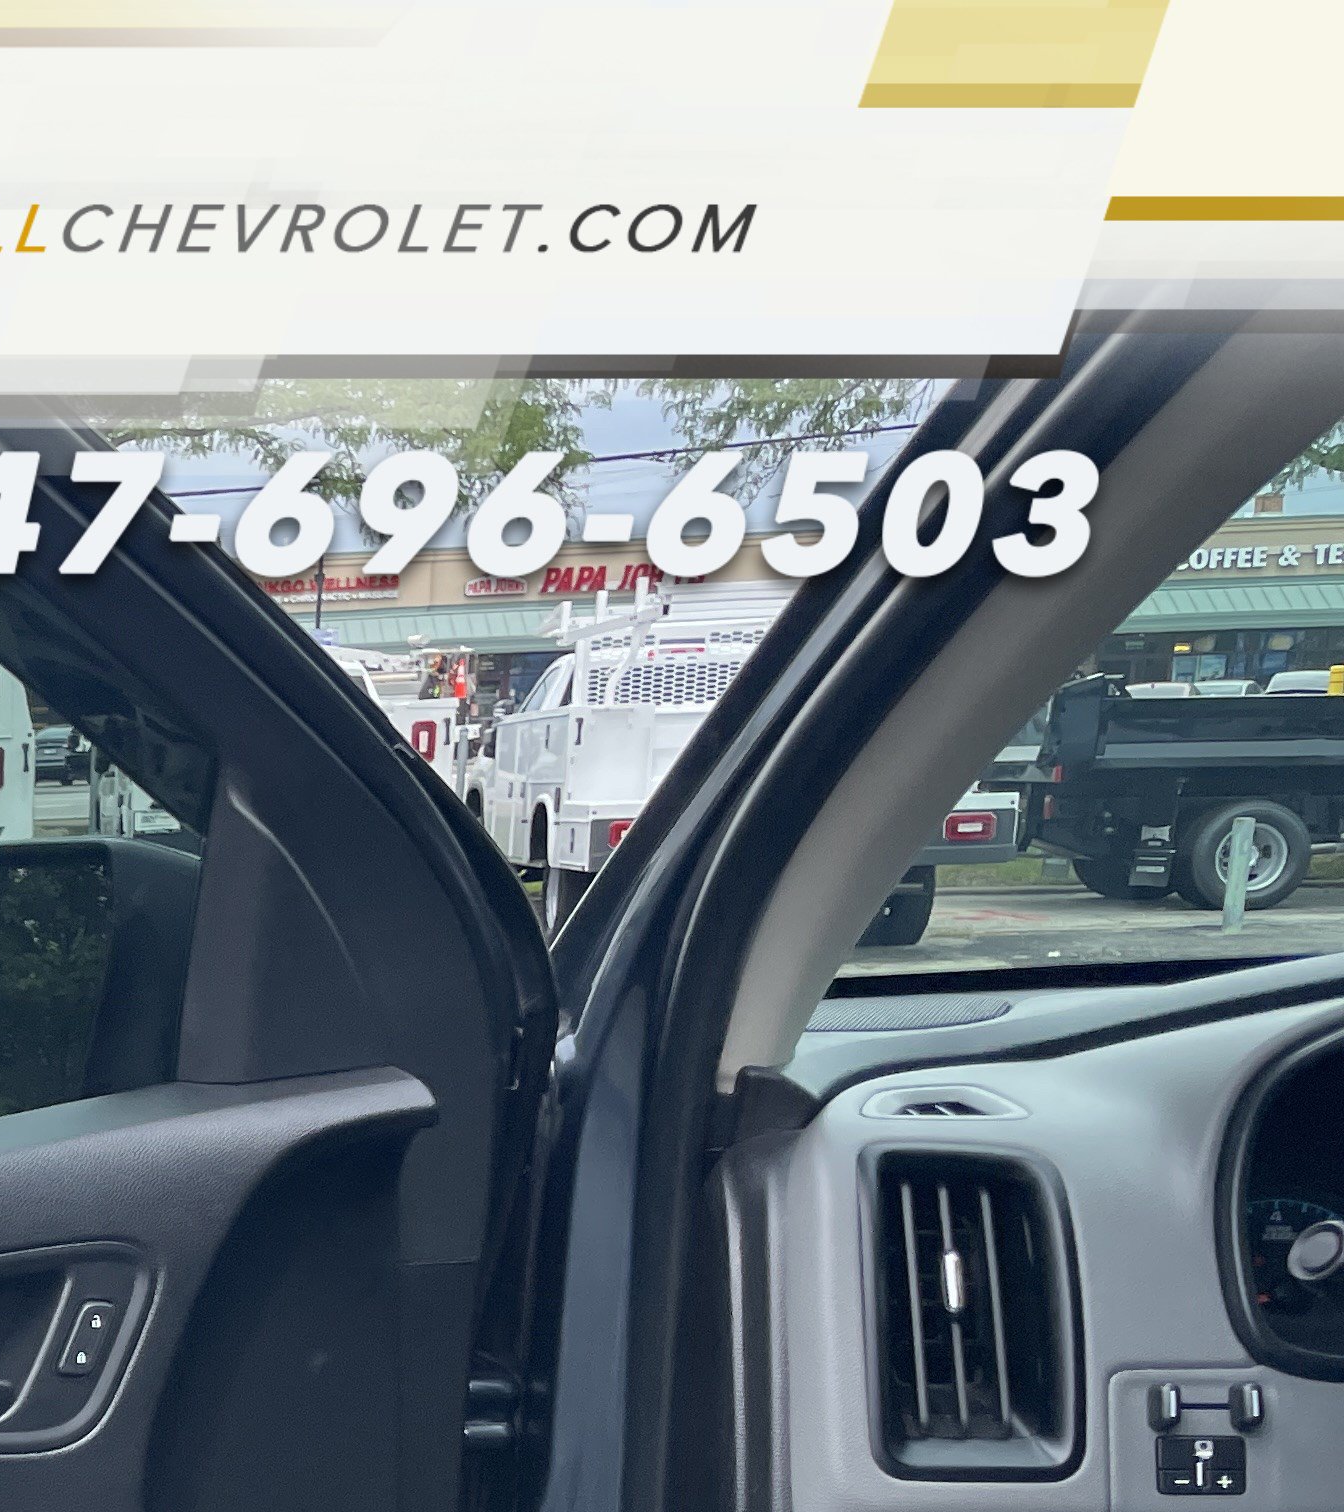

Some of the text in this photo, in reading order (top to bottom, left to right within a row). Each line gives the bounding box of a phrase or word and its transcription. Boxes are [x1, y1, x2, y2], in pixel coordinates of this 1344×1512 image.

[1176, 546, 1269, 571] OFFEE
[1278, 544, 1302, 567] &
[539, 565, 607, 594] PAPA
